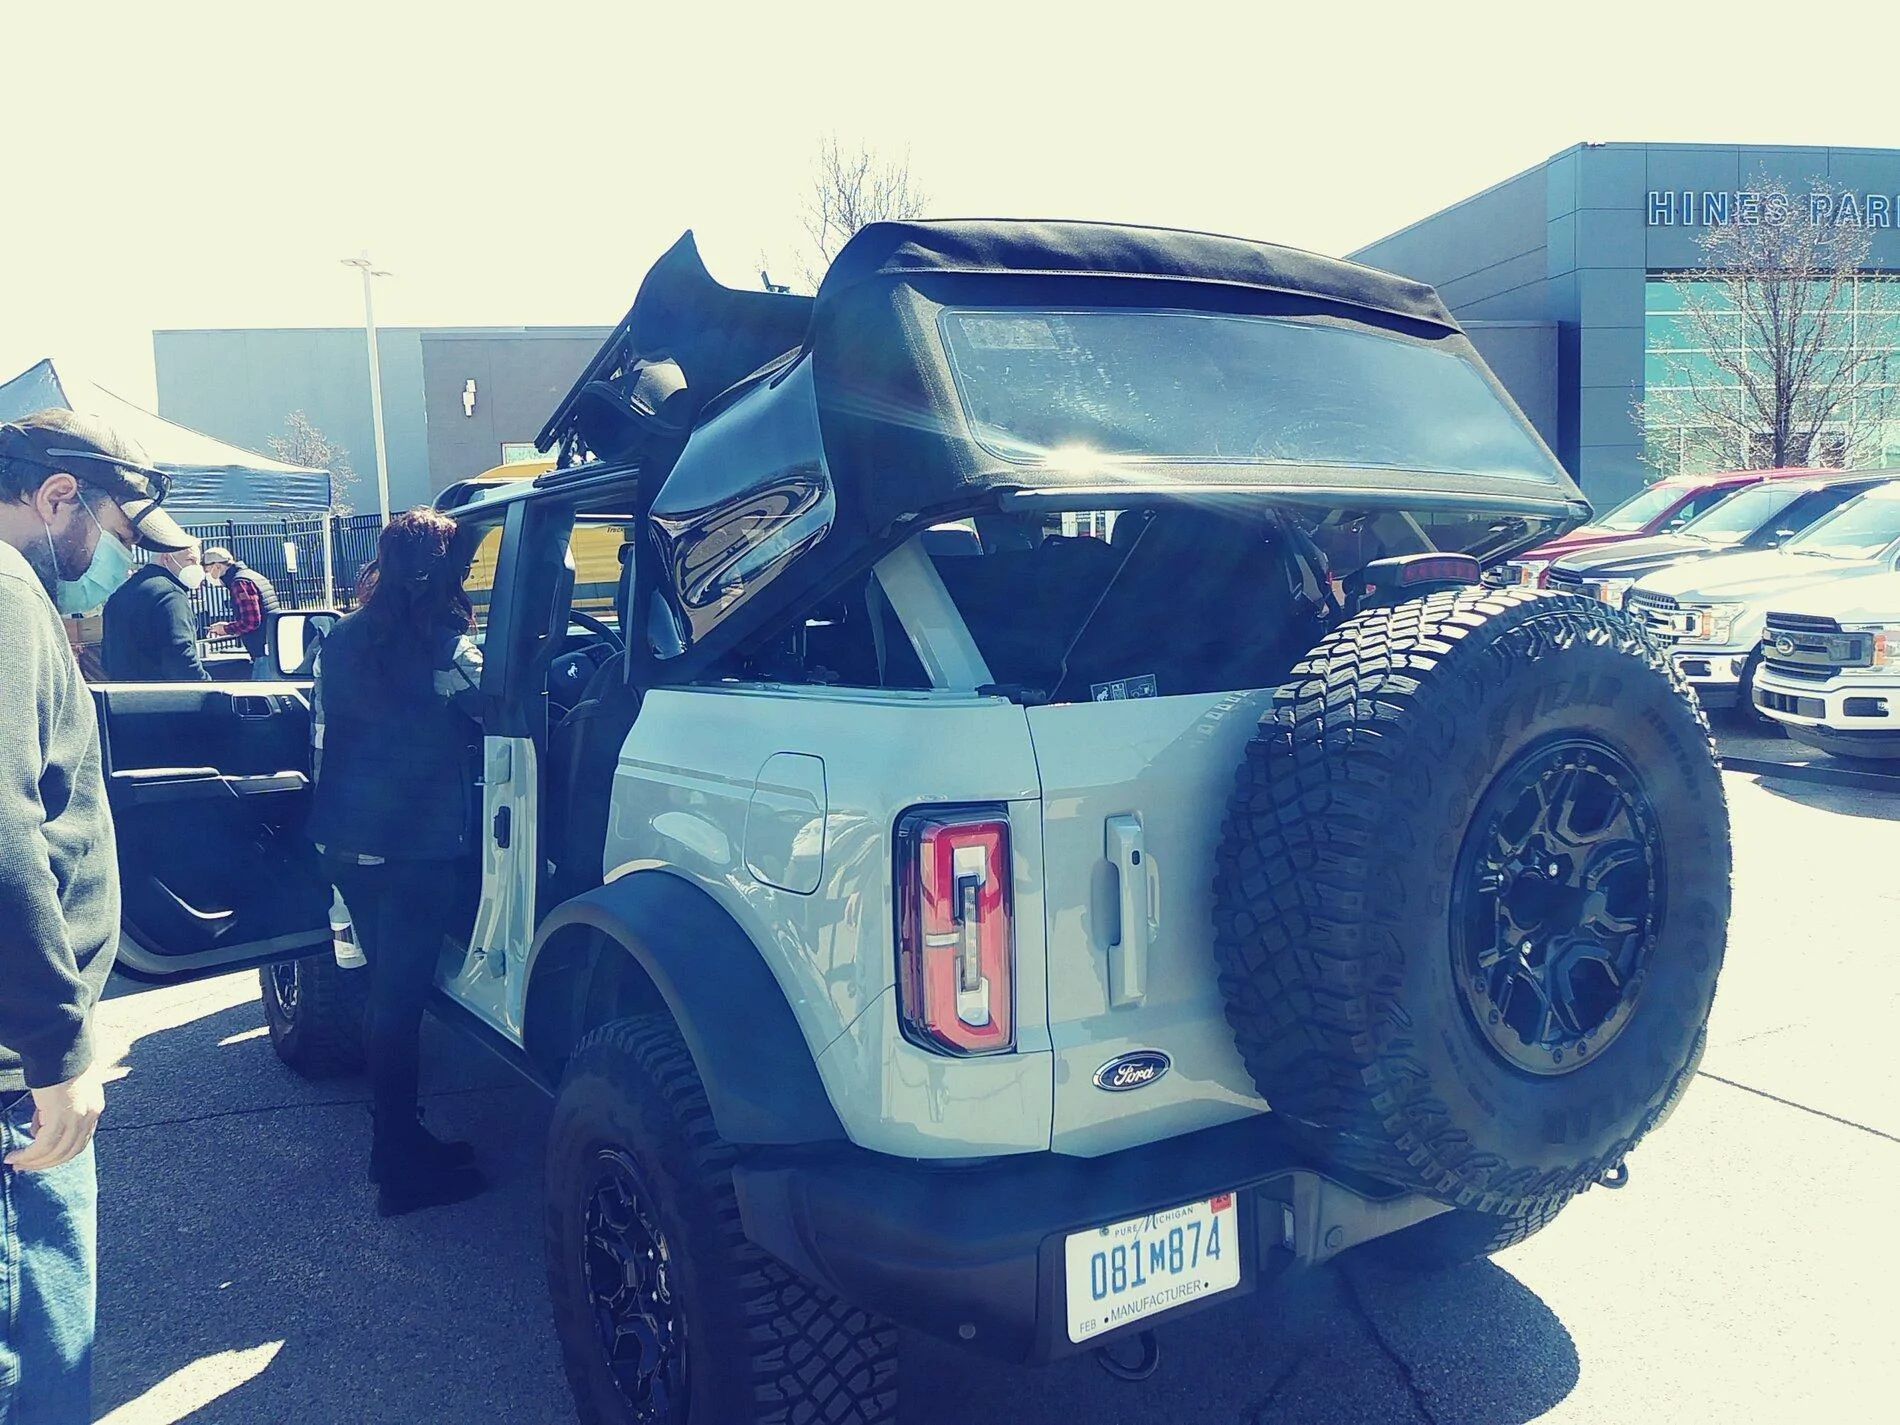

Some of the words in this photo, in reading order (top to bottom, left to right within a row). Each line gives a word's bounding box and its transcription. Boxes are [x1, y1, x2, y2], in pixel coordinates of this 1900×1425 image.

[1648, 191, 1789, 227] HINES
[1810, 193, 1900, 228] PAR
[1113, 1063, 1154, 1086] Ford
[1114, 1225, 1138, 1238] PURE
[1091, 1216, 1221, 1301] 081M874
[1079, 1318, 1097, 1334] FEB
[1111, 1279, 1202, 1321] MANUFACTURER
